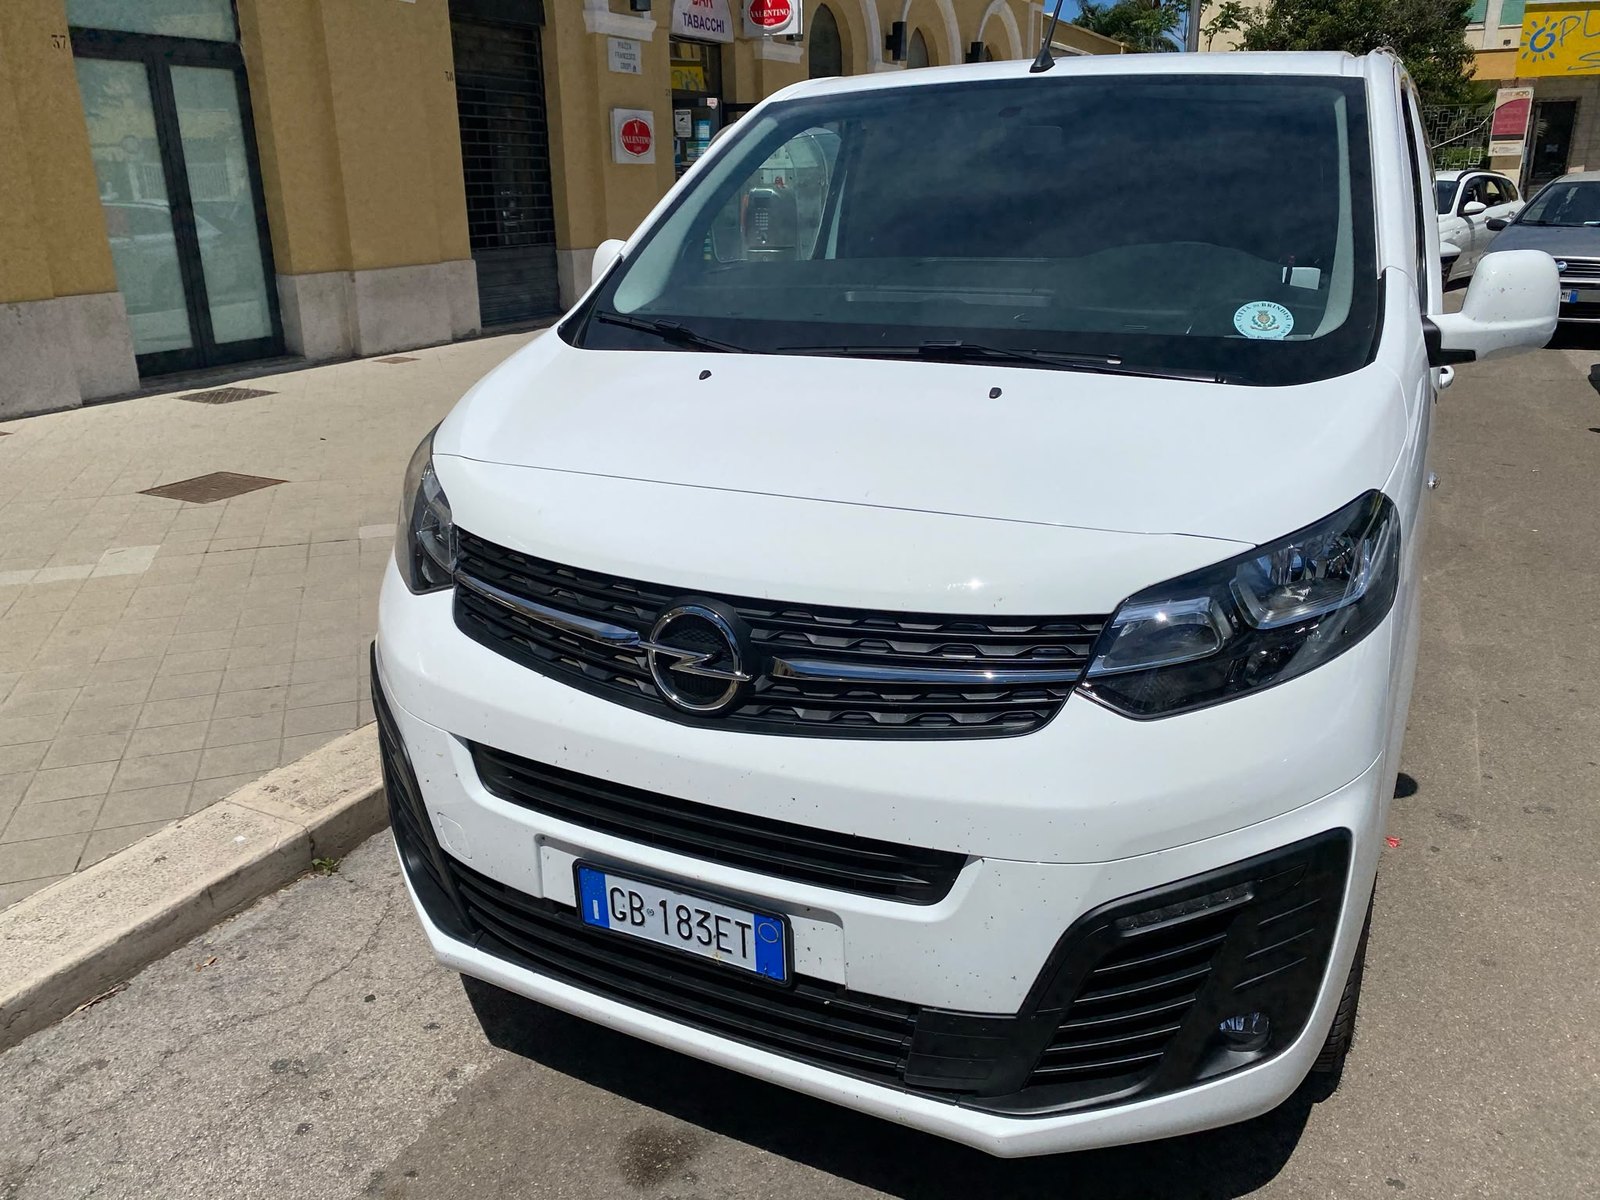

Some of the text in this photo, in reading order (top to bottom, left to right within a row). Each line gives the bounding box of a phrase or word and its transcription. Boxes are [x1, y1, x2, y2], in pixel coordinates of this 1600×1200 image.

[750, 8, 790, 18] VALENTINO
[682, 12, 725, 34] TABACCHI
[51, 34, 66, 49] 37
[622, 135, 651, 145] VALENTINO
[1261, 302, 1292, 321] BRINDISI
